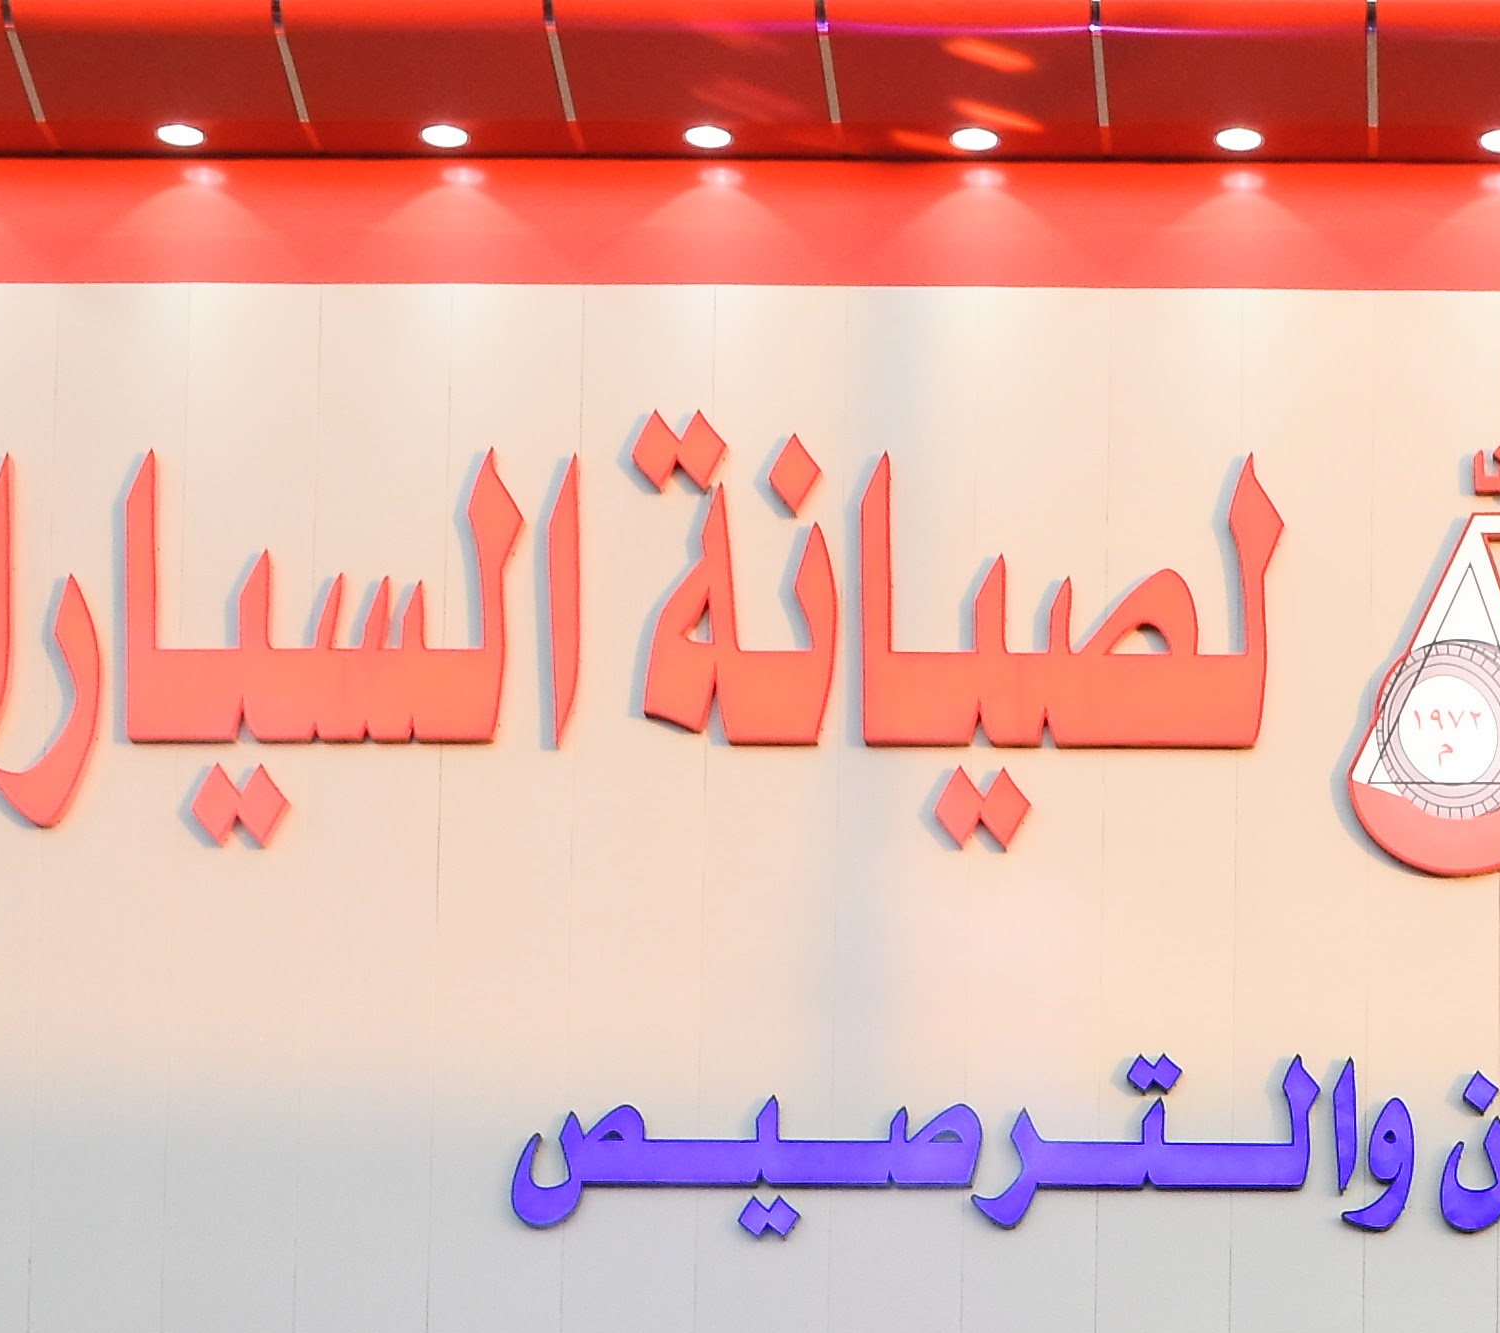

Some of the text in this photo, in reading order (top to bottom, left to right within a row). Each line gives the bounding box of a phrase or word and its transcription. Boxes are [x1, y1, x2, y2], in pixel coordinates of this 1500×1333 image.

[632, 409, 1284, 850] لصيانة
[1412, 708, 1483, 733] ١٩٧٢
[511, 1054, 1415, 1238] والترصيص
